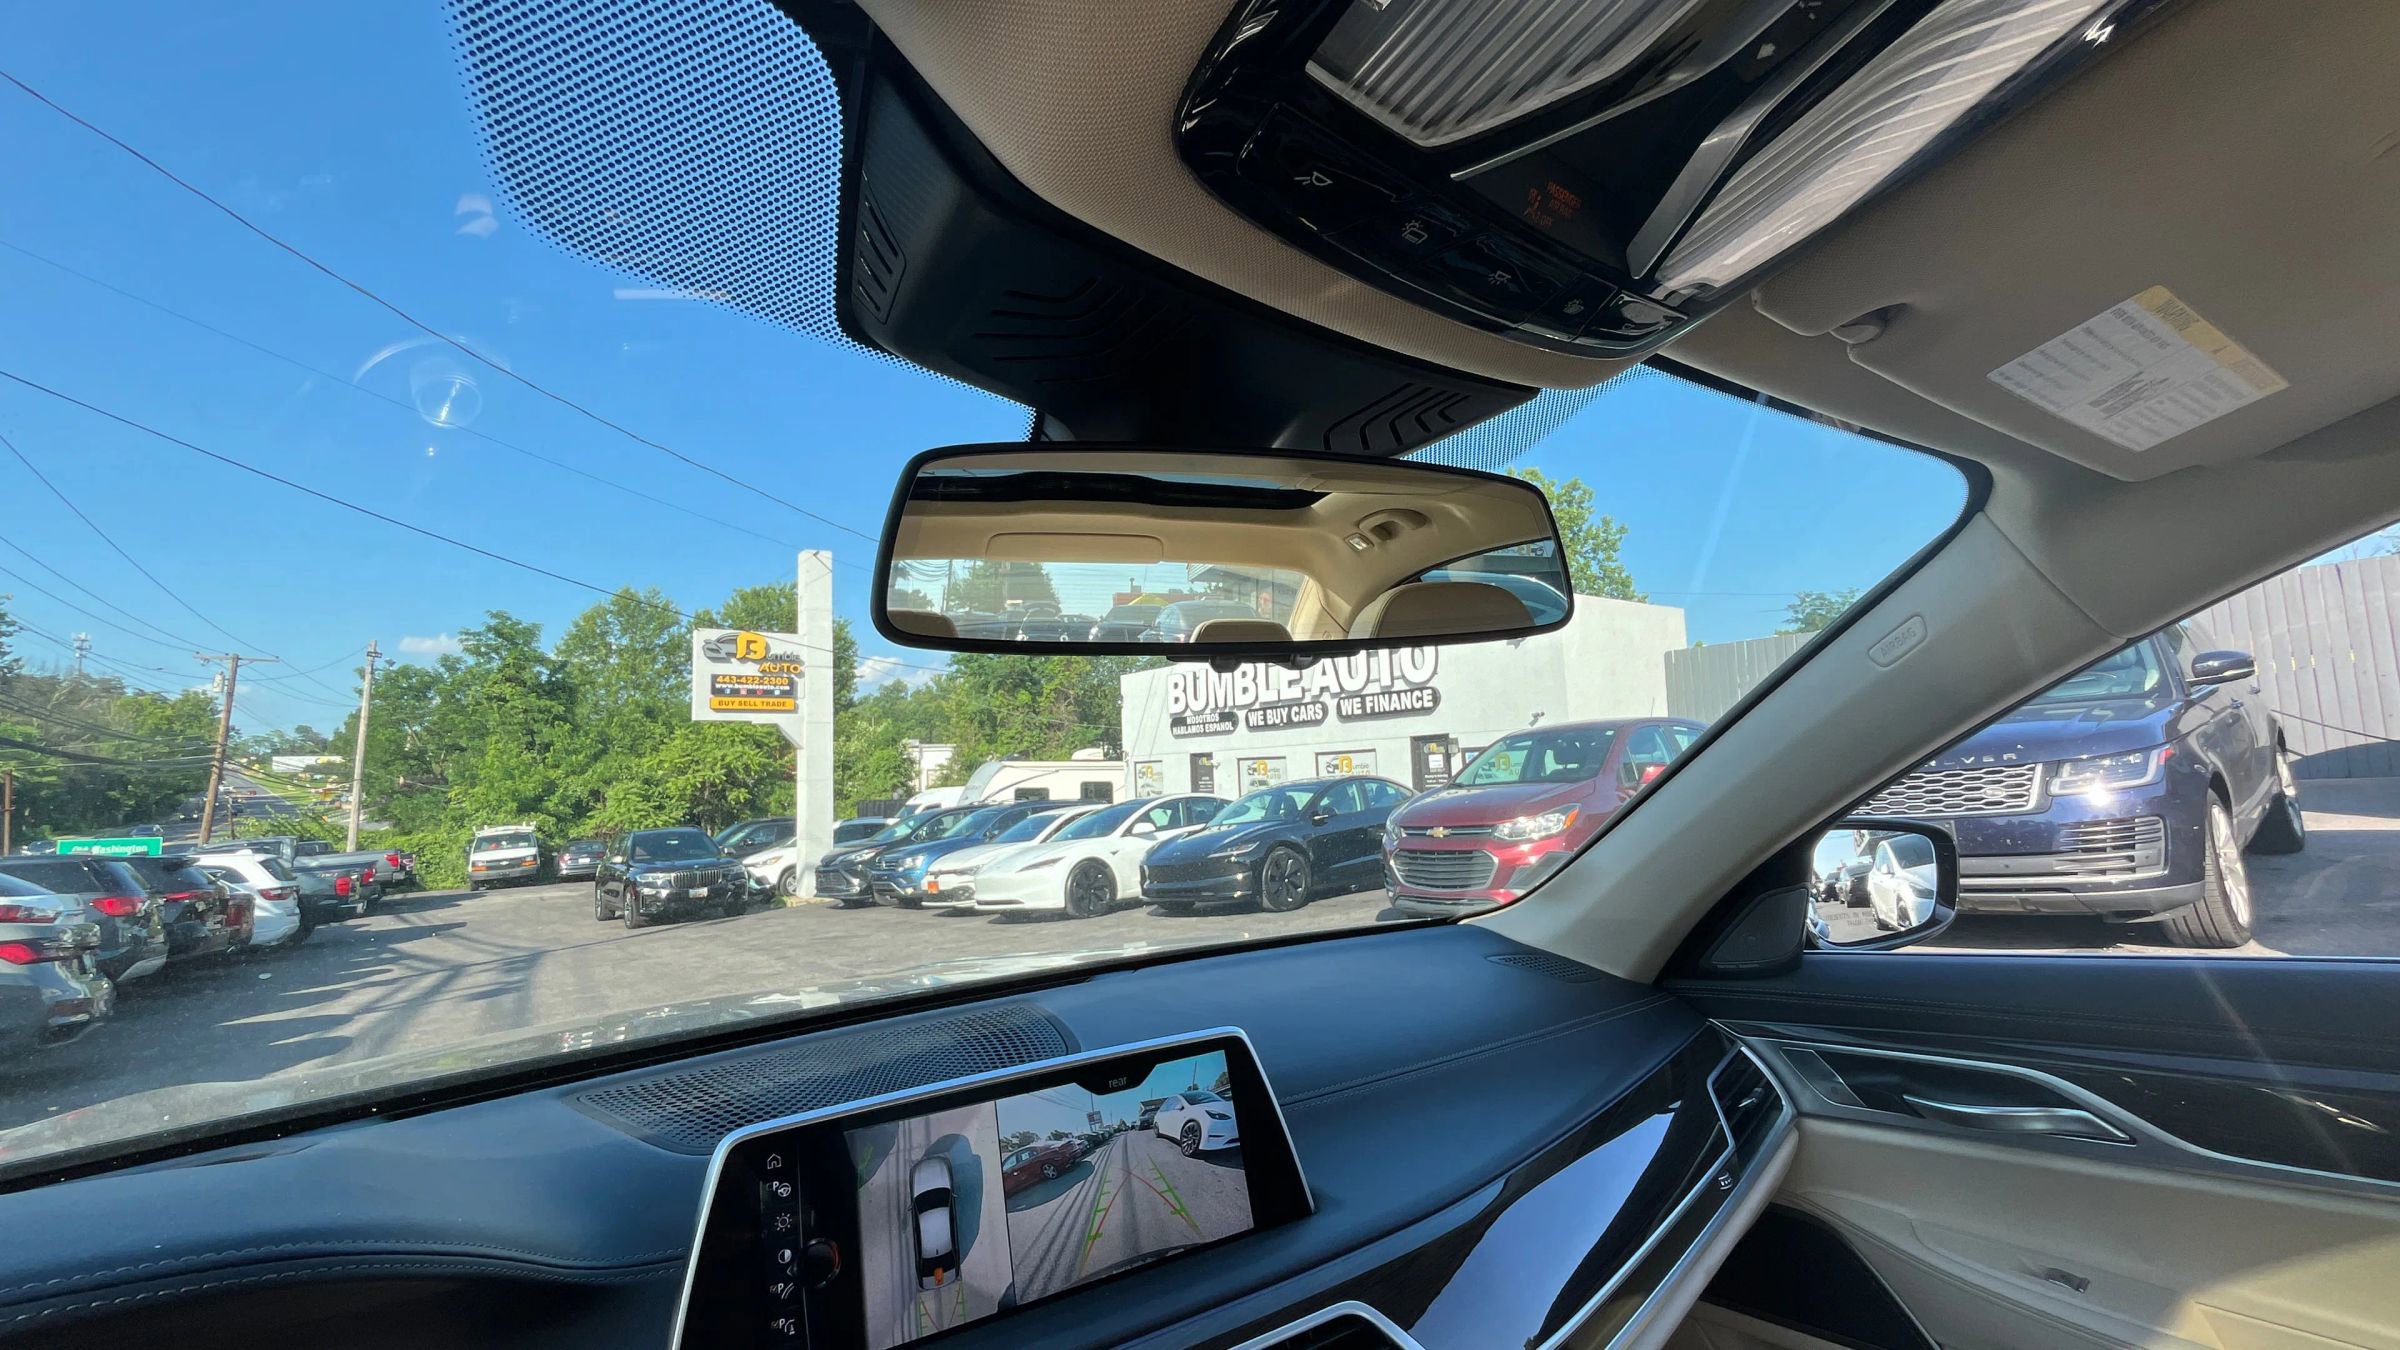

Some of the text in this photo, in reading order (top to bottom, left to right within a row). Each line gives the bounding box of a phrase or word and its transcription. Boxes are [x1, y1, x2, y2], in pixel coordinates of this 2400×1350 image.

[759, 661, 801, 673] AUTO
[716, 675, 789, 686] 443-422-2300
[1168, 645, 1439, 714] BUMBLE AUTO
[718, 699, 736, 707] BUY
[760, 700, 787, 708] TRADE
[1340, 688, 1434, 716] WE FINANCE
[1186, 712, 1220, 724] NOSOTROS
[1248, 703, 1323, 727] WE BUY CARS
[1172, 723, 1204, 735] HABLAMOS
[1108, 1077, 1128, 1089] rear
